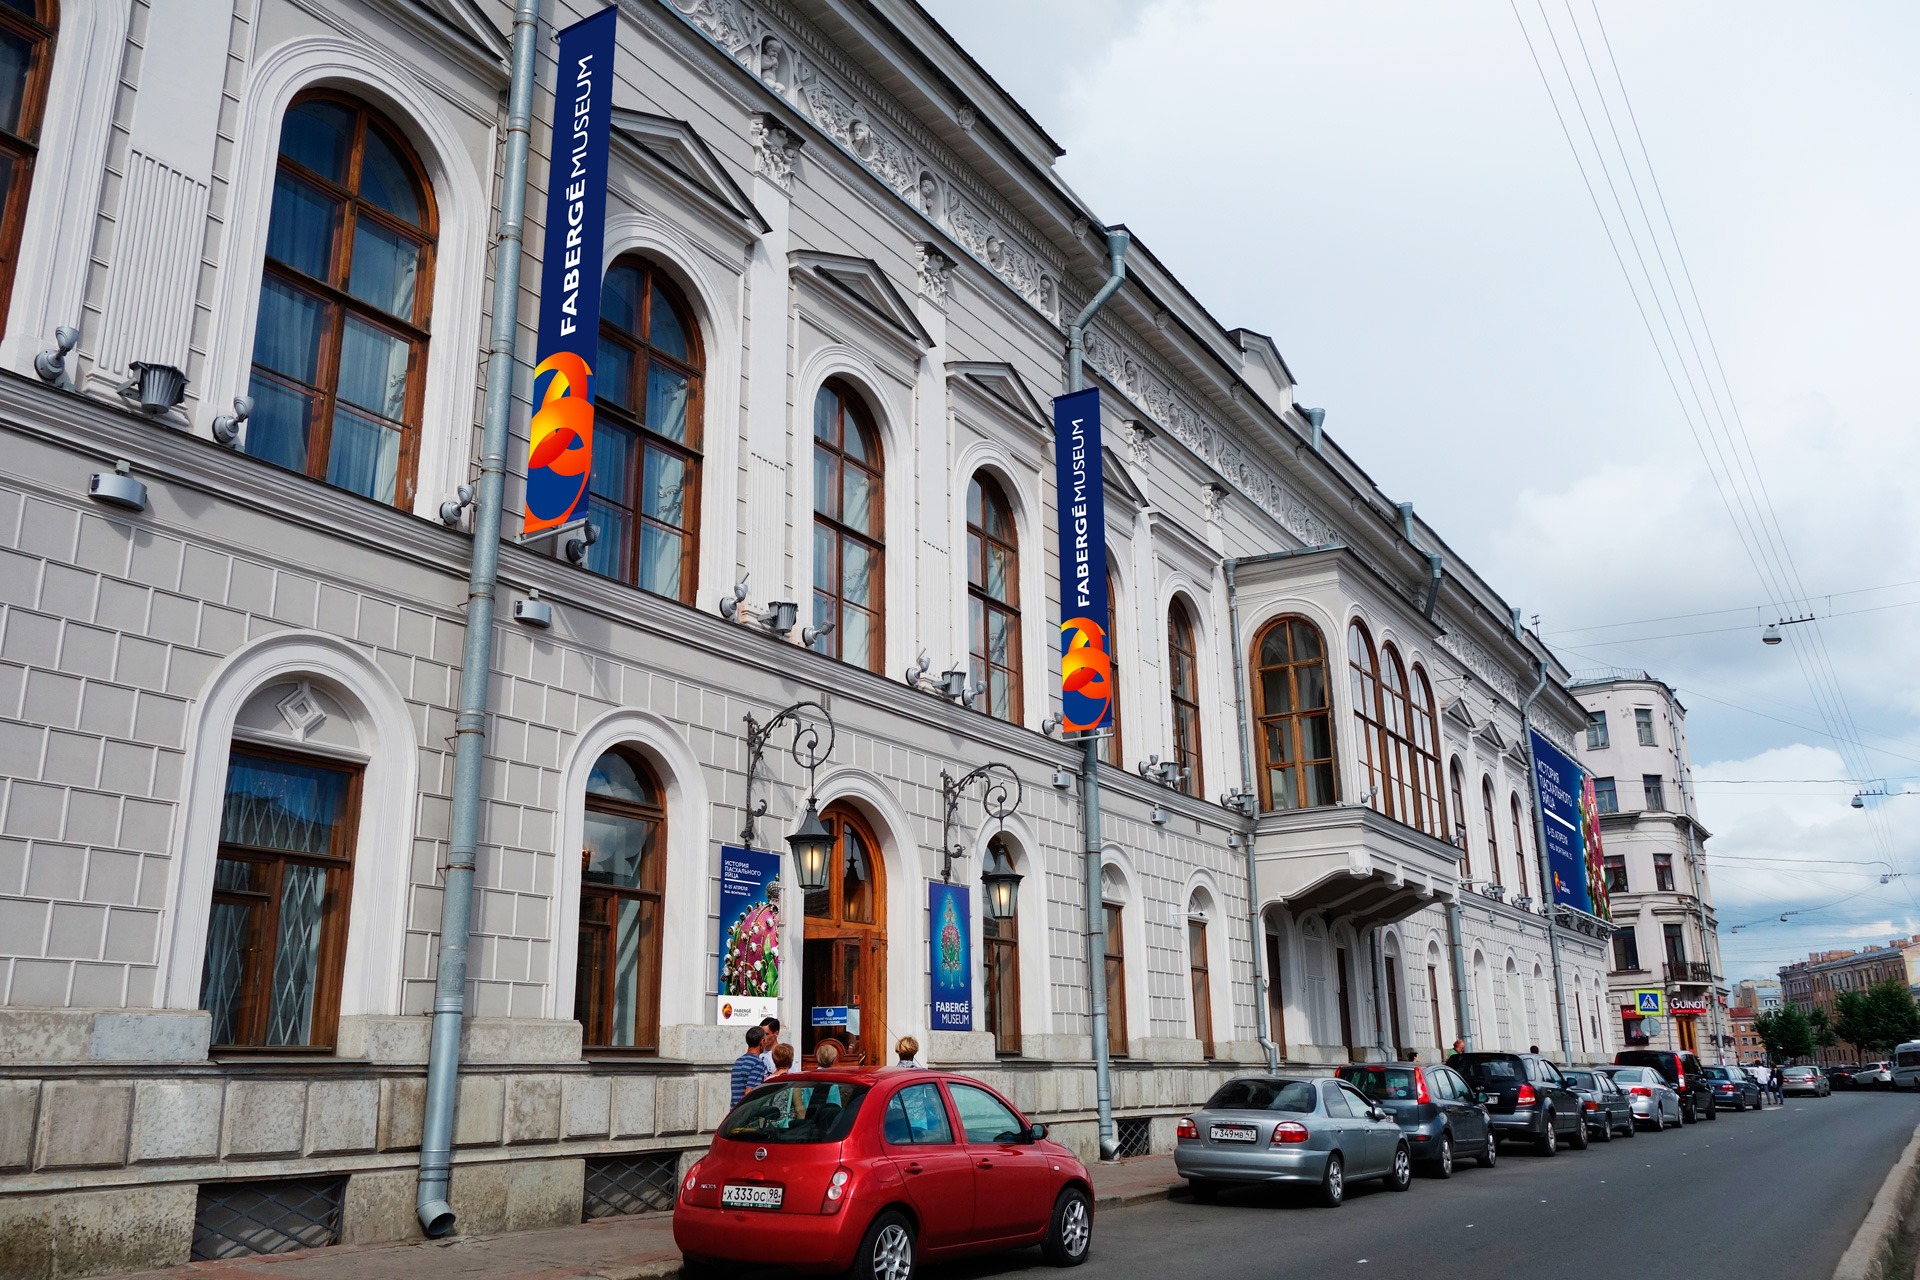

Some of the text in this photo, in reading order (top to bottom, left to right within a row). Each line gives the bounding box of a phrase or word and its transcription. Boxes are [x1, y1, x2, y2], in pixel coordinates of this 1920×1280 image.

[570, 54, 593, 179] MUSEUM
[1072, 418, 1086, 502] MUSEUM
[1536, 758, 1560, 784] ИСТОРИЯ
[1539, 774, 1573, 807] ПАСХАЛЬНОГО
[1541, 790, 1556, 811] ЯЙЦА
[725, 860, 749, 868] ИСТОРИЯ
[725, 866, 761, 876] ПАСХАЛЬНОГО
[941, 1013, 970, 1024] MUSEUM
[768, 1188, 779, 1199] 98
